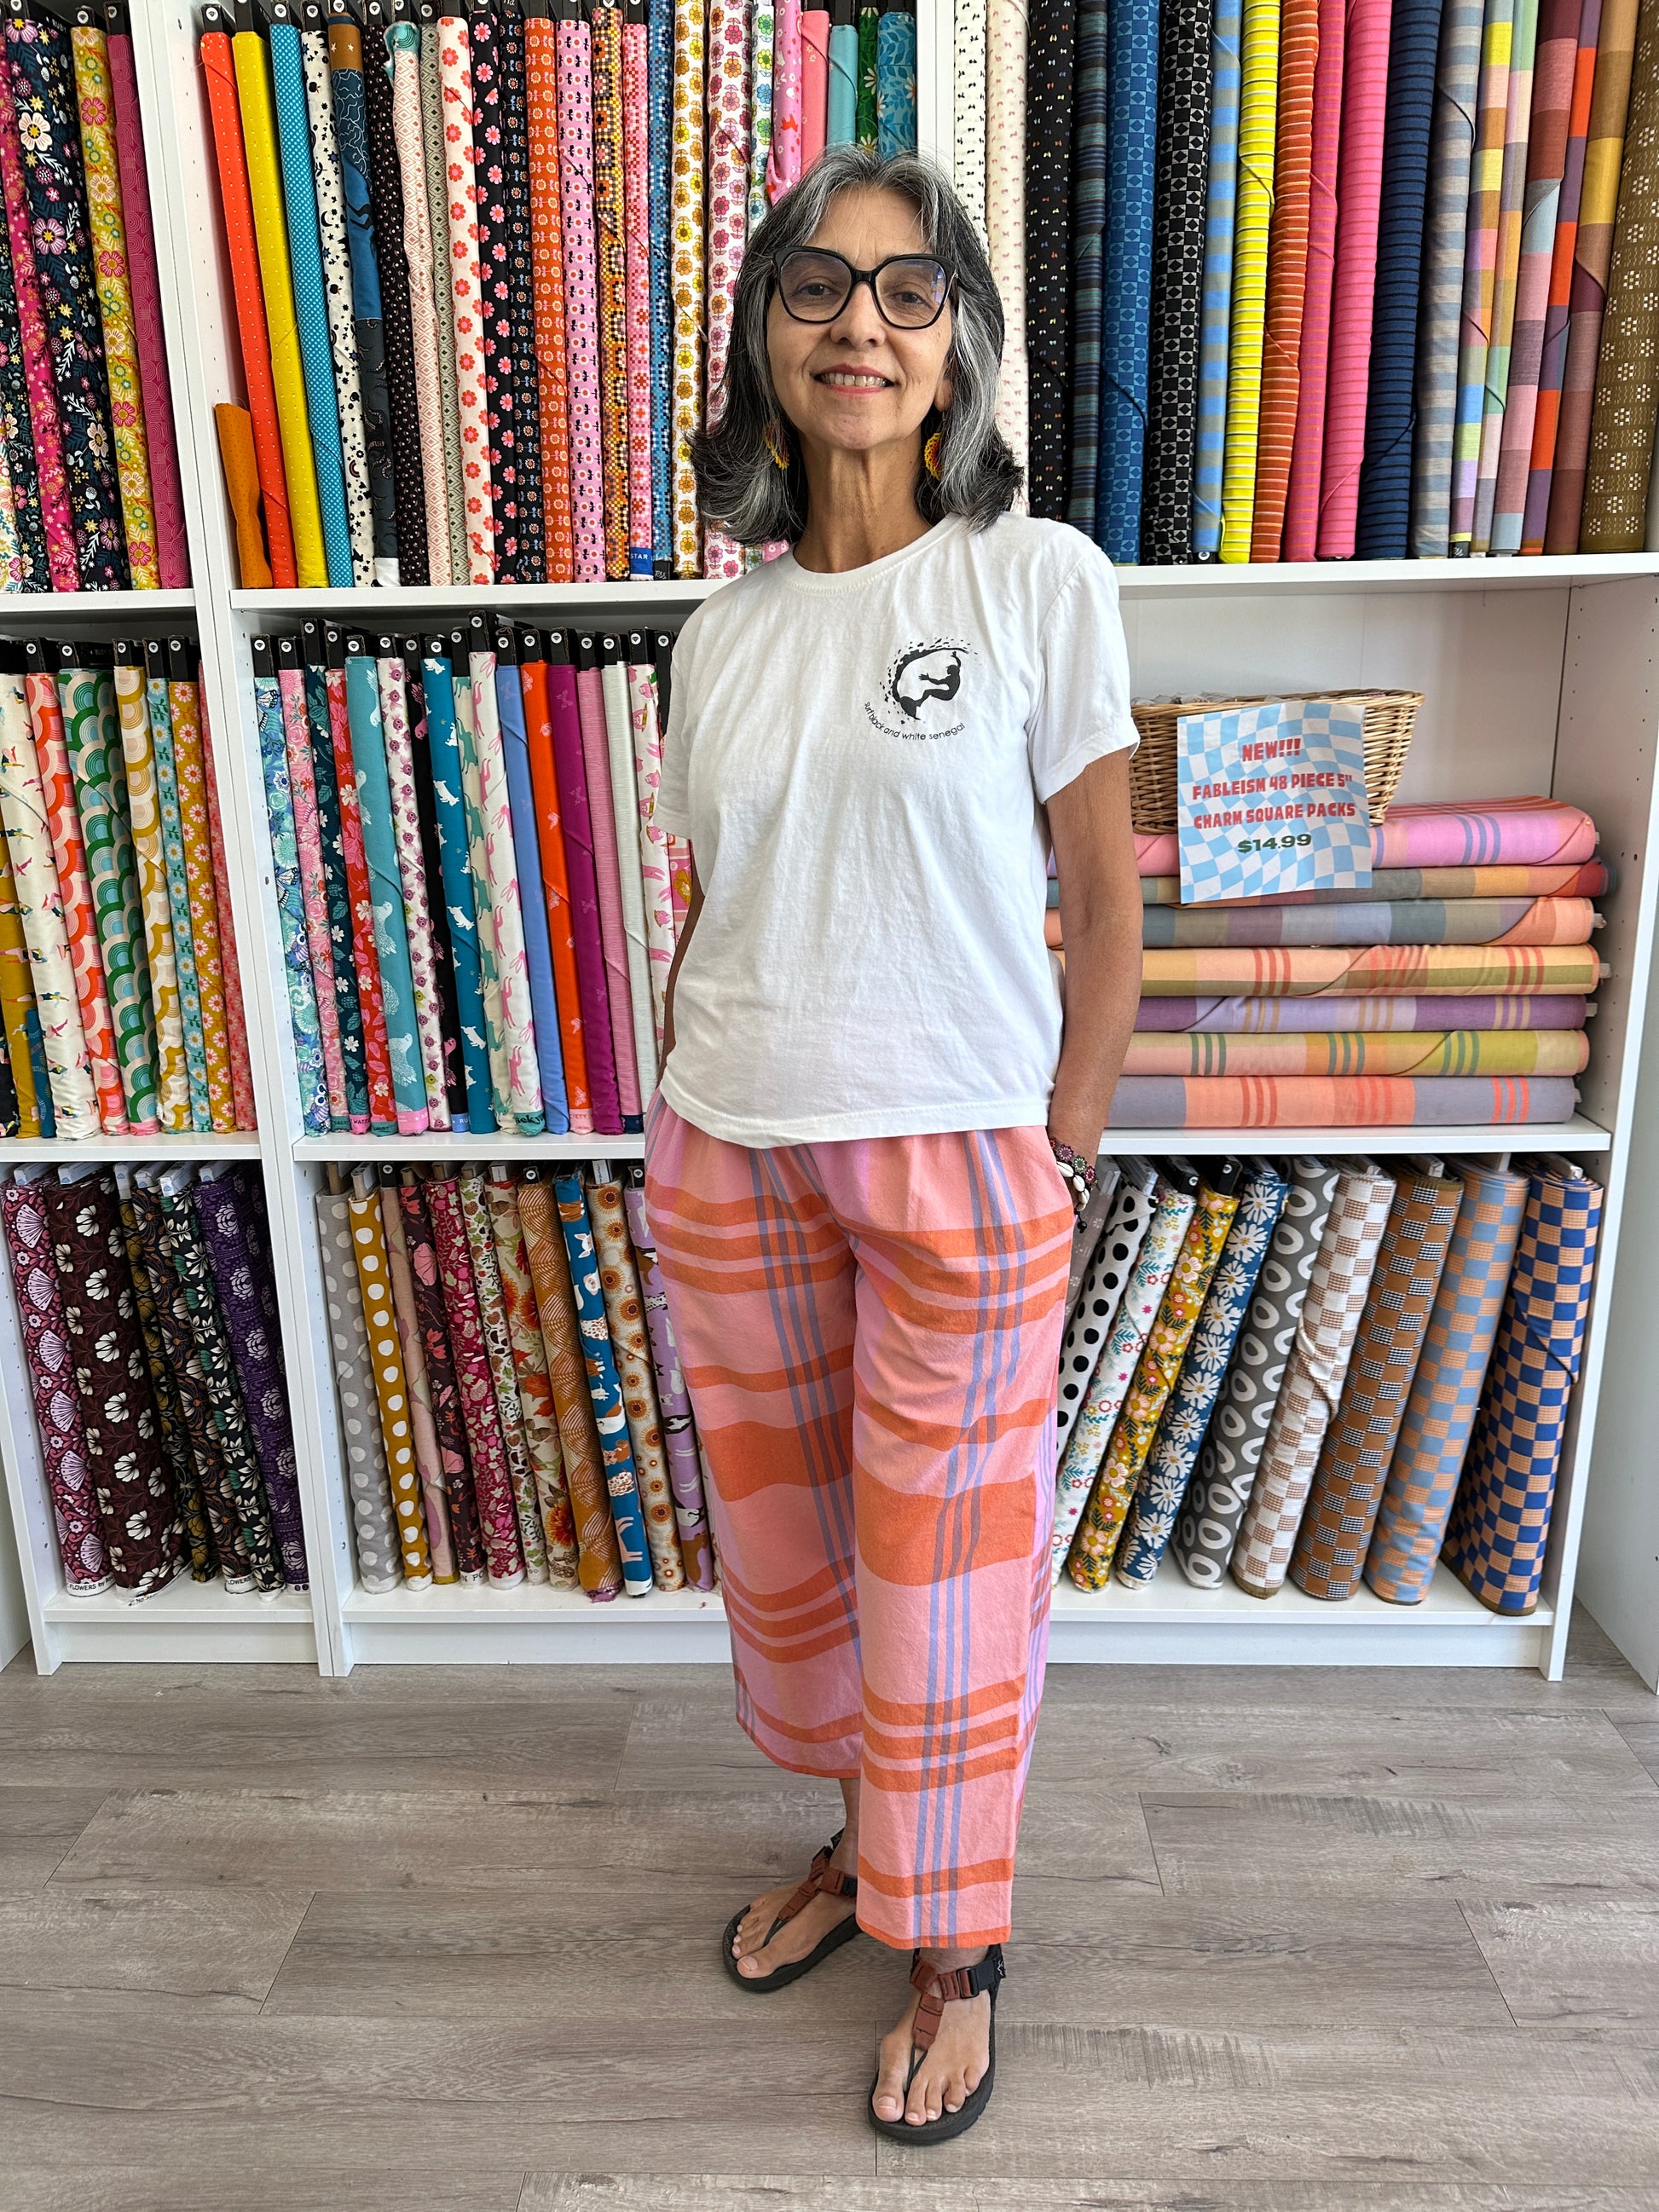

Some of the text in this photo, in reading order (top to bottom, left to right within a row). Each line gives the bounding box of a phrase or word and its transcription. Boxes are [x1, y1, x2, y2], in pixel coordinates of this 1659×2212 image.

[864, 702, 875, 714] surf
[883, 727, 901, 737] and
[928, 722, 966, 740] senegal
[1241, 738, 1301, 762] NEW!!!
[1193, 777, 1266, 800] FABLEISM
[1269, 776, 1287, 790] 48
[1291, 772, 1334, 788] PIECE
[1194, 802, 1356, 829] CHARM SQUARE PACKS
[1237, 833, 1312, 854] $14.99
[69, 1583, 97, 1591] FLOWERS
